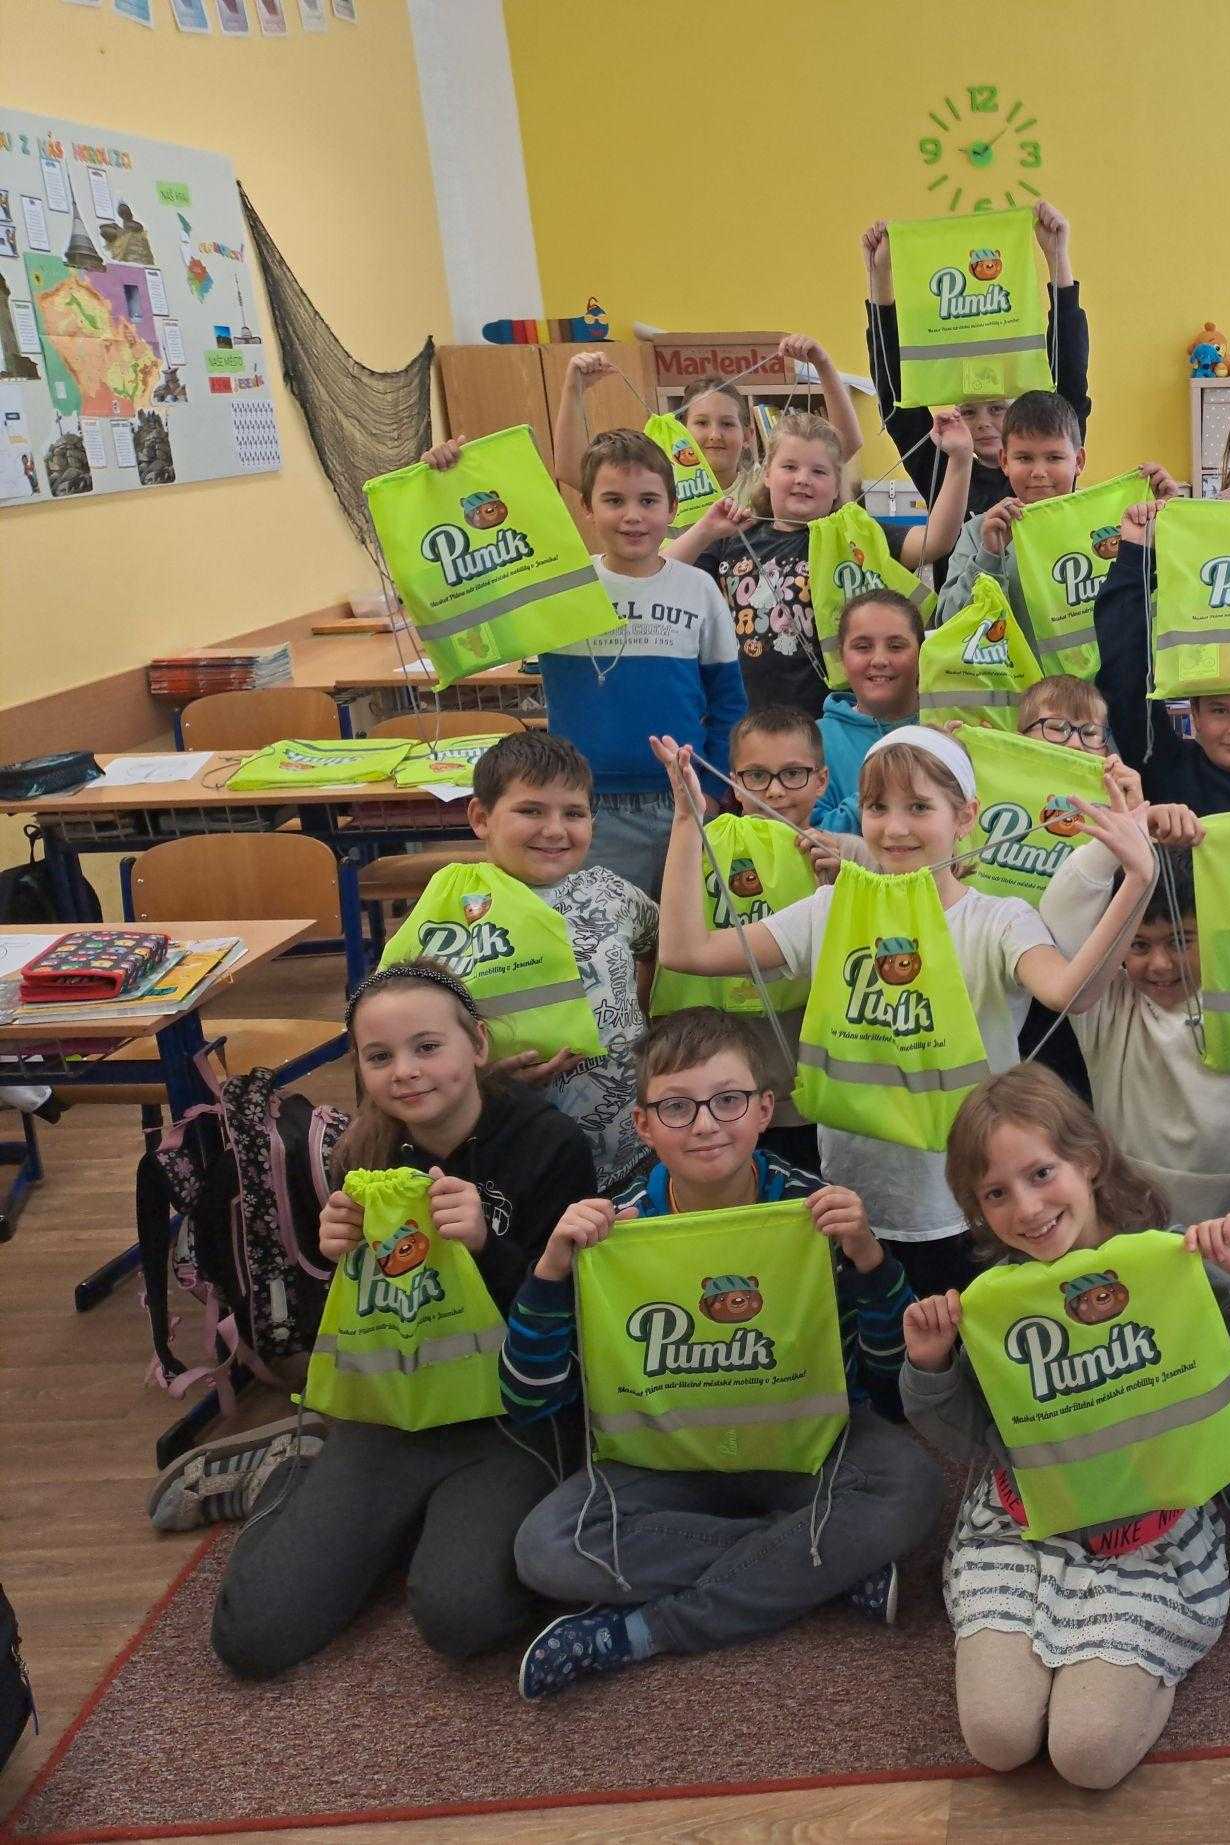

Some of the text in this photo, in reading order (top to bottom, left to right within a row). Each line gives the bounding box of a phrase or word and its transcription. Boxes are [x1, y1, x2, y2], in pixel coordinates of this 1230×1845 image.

[966, 86, 998, 112] 12
[919, 137, 942, 164] 9
[1019, 141, 1041, 168] 3
[929, 267, 1012, 320] Pumík
[656, 349, 785, 376] Marlenka
[421, 523, 534, 587] Pumík
[652, 603, 698, 629] OUT
[626, 1301, 777, 1377] Pumík
[1005, 1314, 1161, 1403] Pumík
[1100, 1521, 1142, 1550] NIKE
